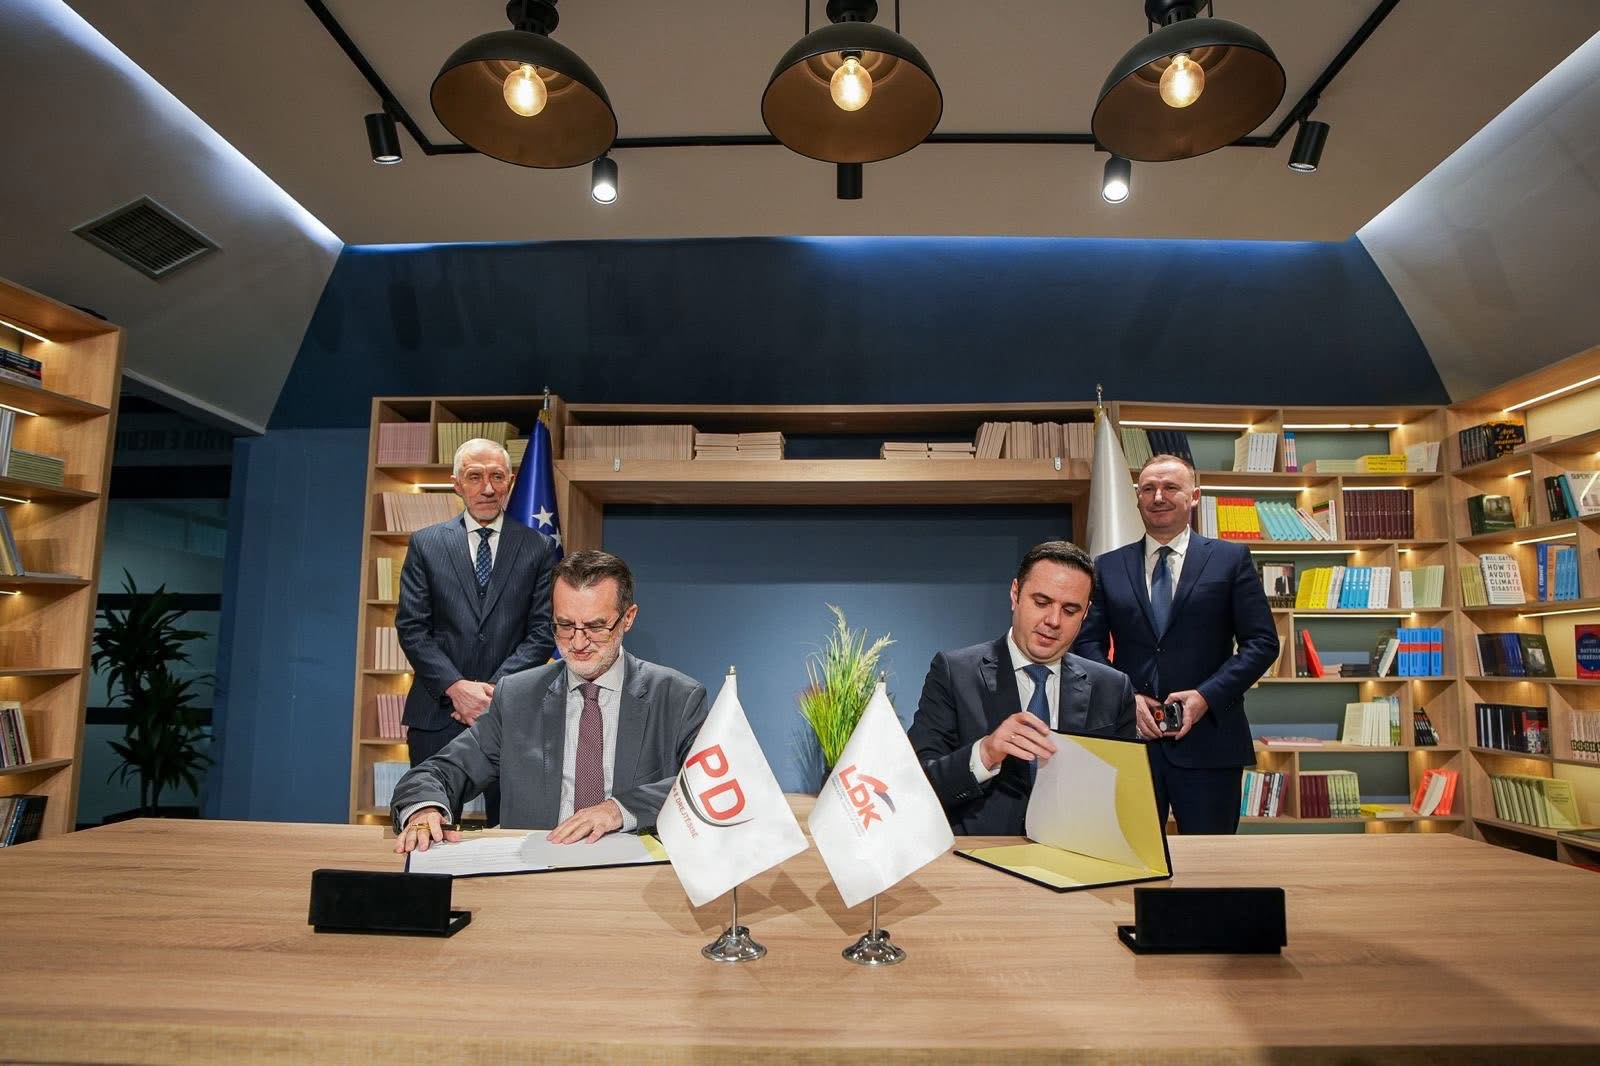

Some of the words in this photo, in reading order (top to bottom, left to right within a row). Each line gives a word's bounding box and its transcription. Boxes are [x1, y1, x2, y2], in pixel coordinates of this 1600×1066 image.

[1487, 563, 1504, 571] HOW
[1508, 563, 1517, 571] TO
[685, 743, 746, 821] PD
[838, 764, 883, 831] LDK
